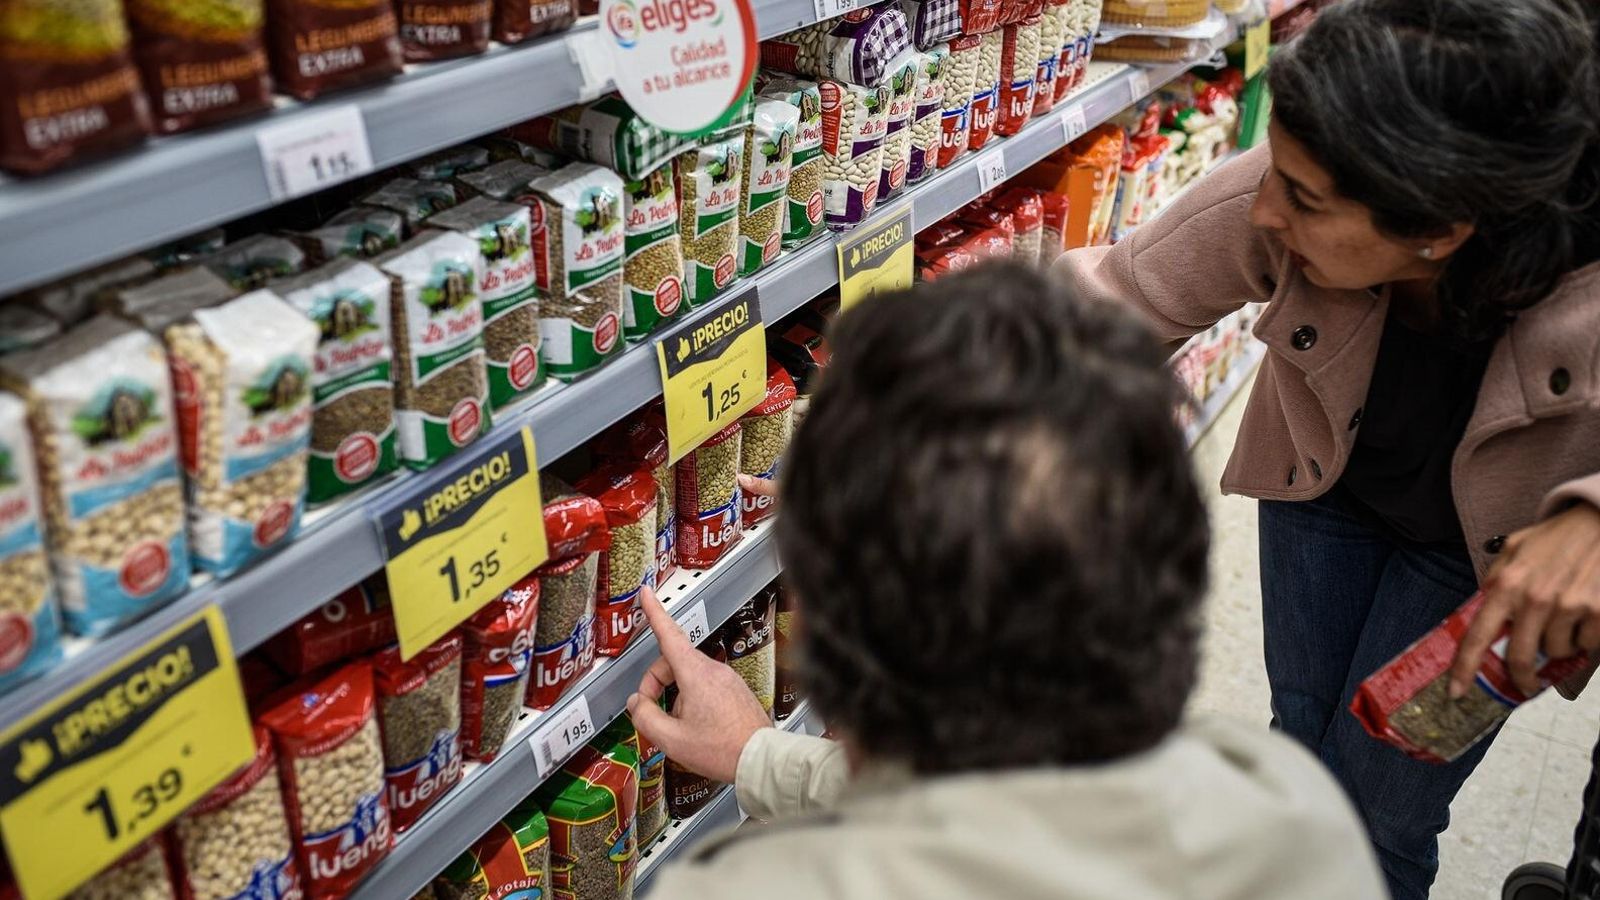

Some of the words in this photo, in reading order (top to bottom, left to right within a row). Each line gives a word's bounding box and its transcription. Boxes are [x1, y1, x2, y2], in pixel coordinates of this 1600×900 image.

[641, 0, 716, 32] eliges
[401, 25, 461, 44] EXTRA
[671, 34, 727, 66] Calidad
[299, 47, 364, 77] EXTRA
[643, 78, 652, 93] a
[654, 73, 671, 91] tu
[673, 61, 731, 87] alcance
[162, 83, 238, 114] EXTRA
[24, 105, 109, 149] EXTRA
[627, 209, 646, 227] La
[862, 222, 904, 260] ¡PRECIO!
[691, 301, 749, 351] ¡PRECIO!
[702, 381, 740, 422] 1,25
[763, 399, 792, 414] LENTEJAS
[423, 451, 511, 522] ¡PRECIO!
[439, 550, 501, 602] 1,35
[746, 623, 772, 649] eliges
[53, 646, 193, 756] ¡PRECIO!
[83, 767, 183, 842] 1,39
[675, 788, 709, 806] EXTRA
[496, 876, 538, 898] Potaje
